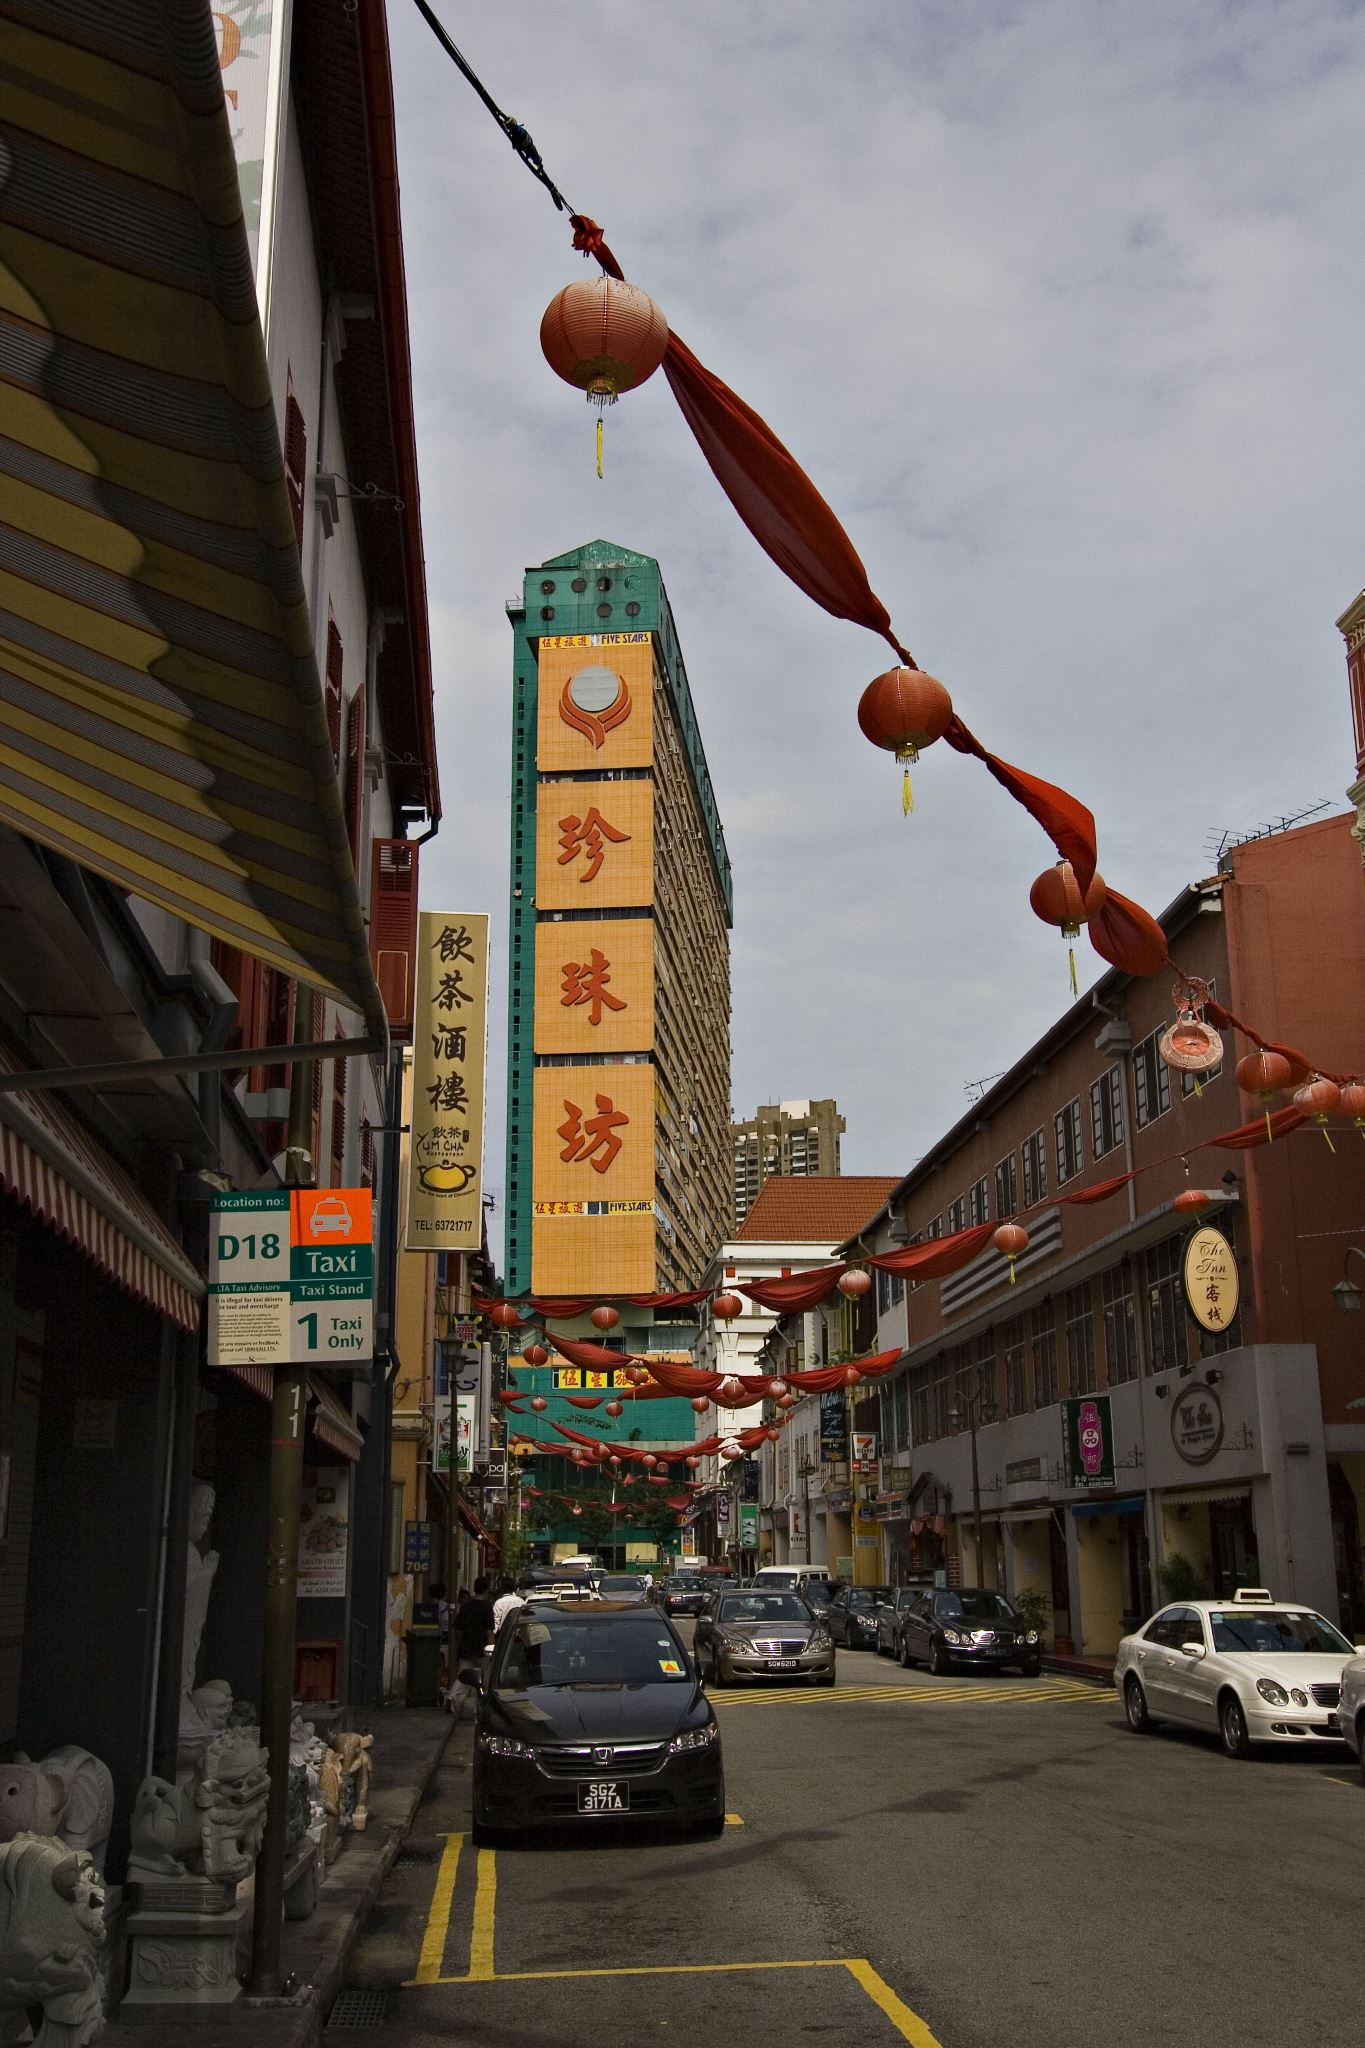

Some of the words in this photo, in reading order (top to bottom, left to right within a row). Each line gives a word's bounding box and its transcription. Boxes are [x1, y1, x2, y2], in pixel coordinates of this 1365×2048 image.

[601, 634, 620, 644] FIVE
[623, 633, 649, 643] STARS
[558, 807, 631, 1173] 珍珠坊
[426, 926, 475, 1115] 飲茶酒樓
[432, 1126, 462, 1139] 飲茶
[443, 1140, 464, 1152] CHA
[214, 1197, 263, 1208] Location
[266, 1197, 284, 1208] no:
[610, 1202, 627, 1212] FIVE
[628, 1202, 652, 1212] STARS
[415, 1220, 433, 1231] TEL:
[435, 1220, 473, 1232] 63721717
[218, 1233, 280, 1260] D18
[1195, 1241, 1225, 1256] The
[305, 1249, 357, 1274] Taxi
[1196, 1258, 1226, 1274] Inn
[217, 1285, 230, 1293] LTA
[232, 1285, 247, 1293] Taxi
[248, 1284, 281, 1293] Advisory
[300, 1285, 325, 1297] Taxi
[329, 1283, 364, 1296] Stand
[330, 1316, 362, 1331] Taxi
[297, 1312, 318, 1350] 1
[328, 1335, 364, 1350] Only
[589, 1783, 617, 1796] SGZ
[584, 1795, 623, 1809] 3171A
